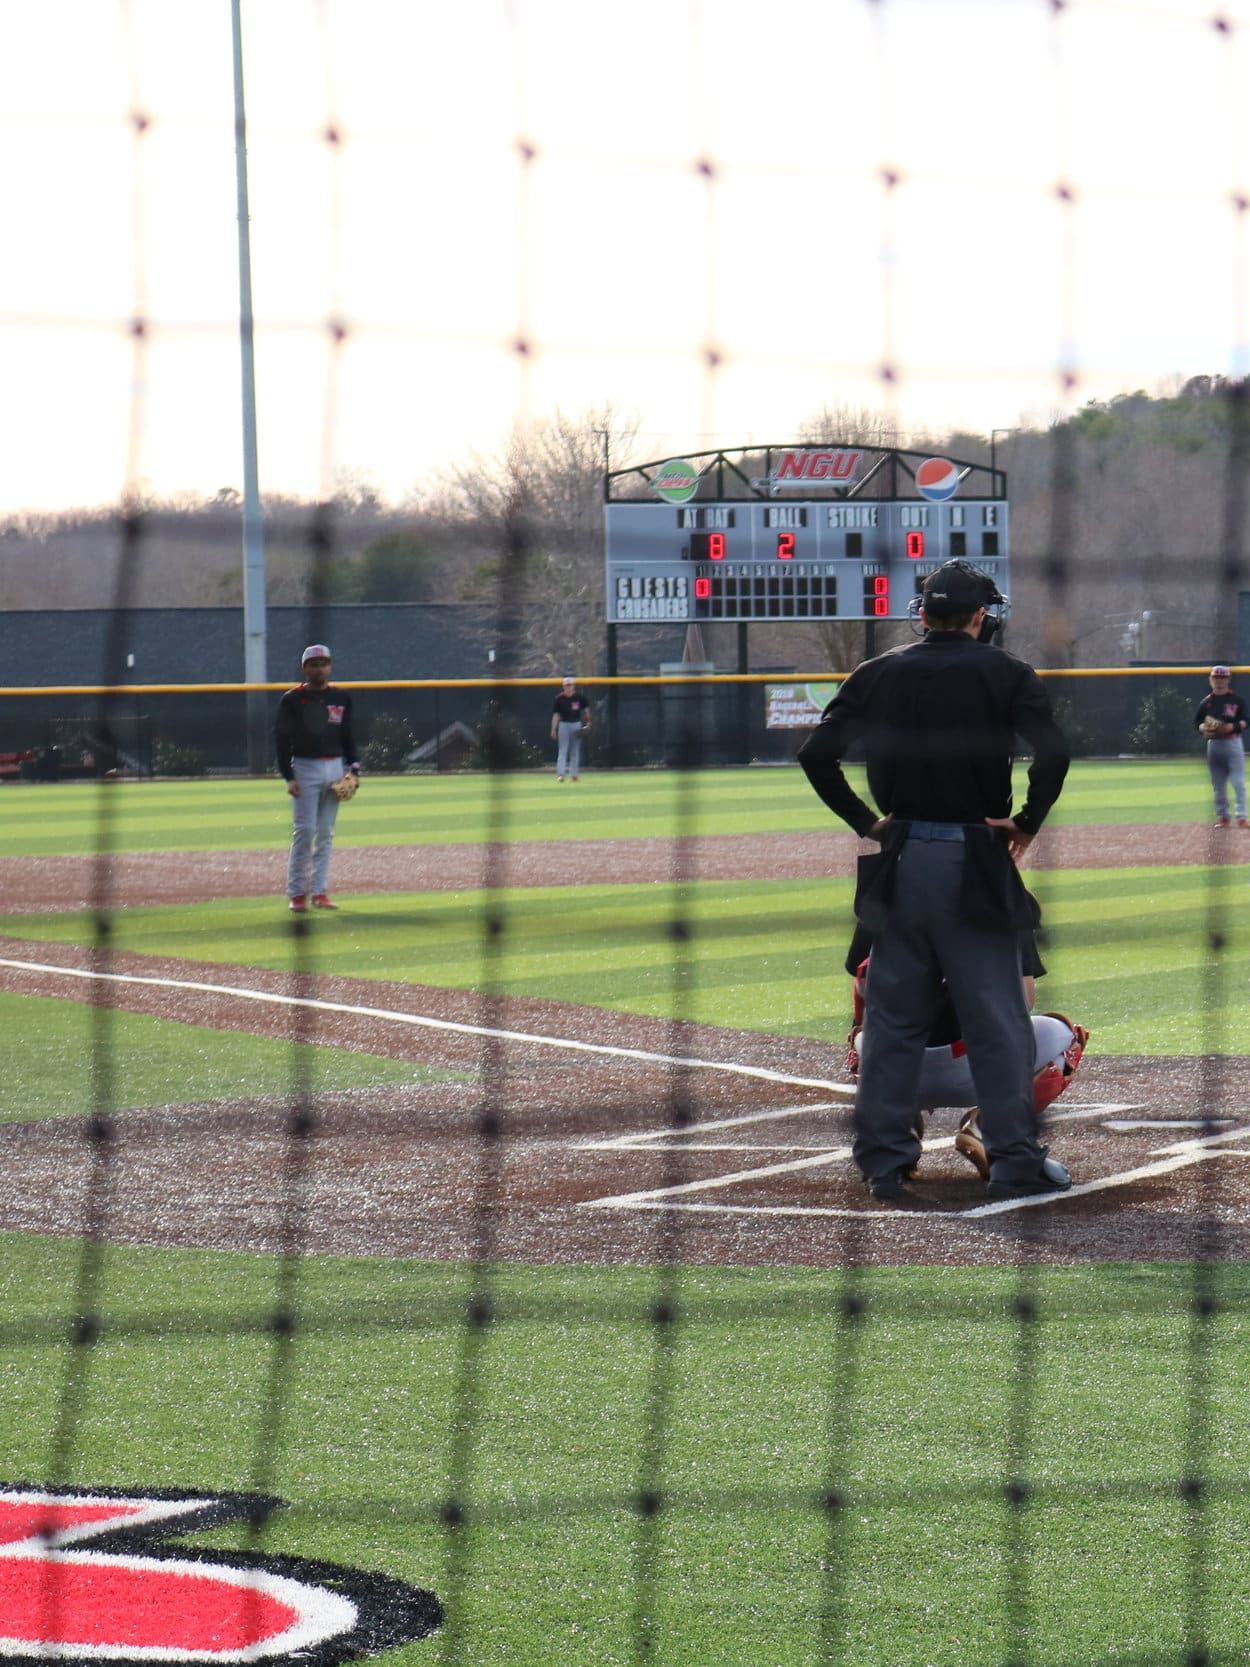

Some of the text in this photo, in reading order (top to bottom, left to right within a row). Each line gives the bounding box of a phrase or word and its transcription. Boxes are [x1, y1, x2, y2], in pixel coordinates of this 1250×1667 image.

[775, 452, 860, 479] NGU
[683, 508, 729, 528] AT BAT
[769, 508, 802, 528] BALL
[829, 507, 878, 528] STRIKE
[901, 508, 928, 527] OUT
[986, 507, 995, 526] E
[709, 533, 725, 560] 8
[777, 533, 796, 560] 2
[906, 531, 924, 559] 0
[617, 577, 688, 597] GUESTS
[695, 578, 710, 598] 0
[874, 576, 889, 596] 0
[616, 597, 688, 618] CRUSADERS
[874, 597, 889, 616] 0
[769, 711, 822, 724] CHAMPI
